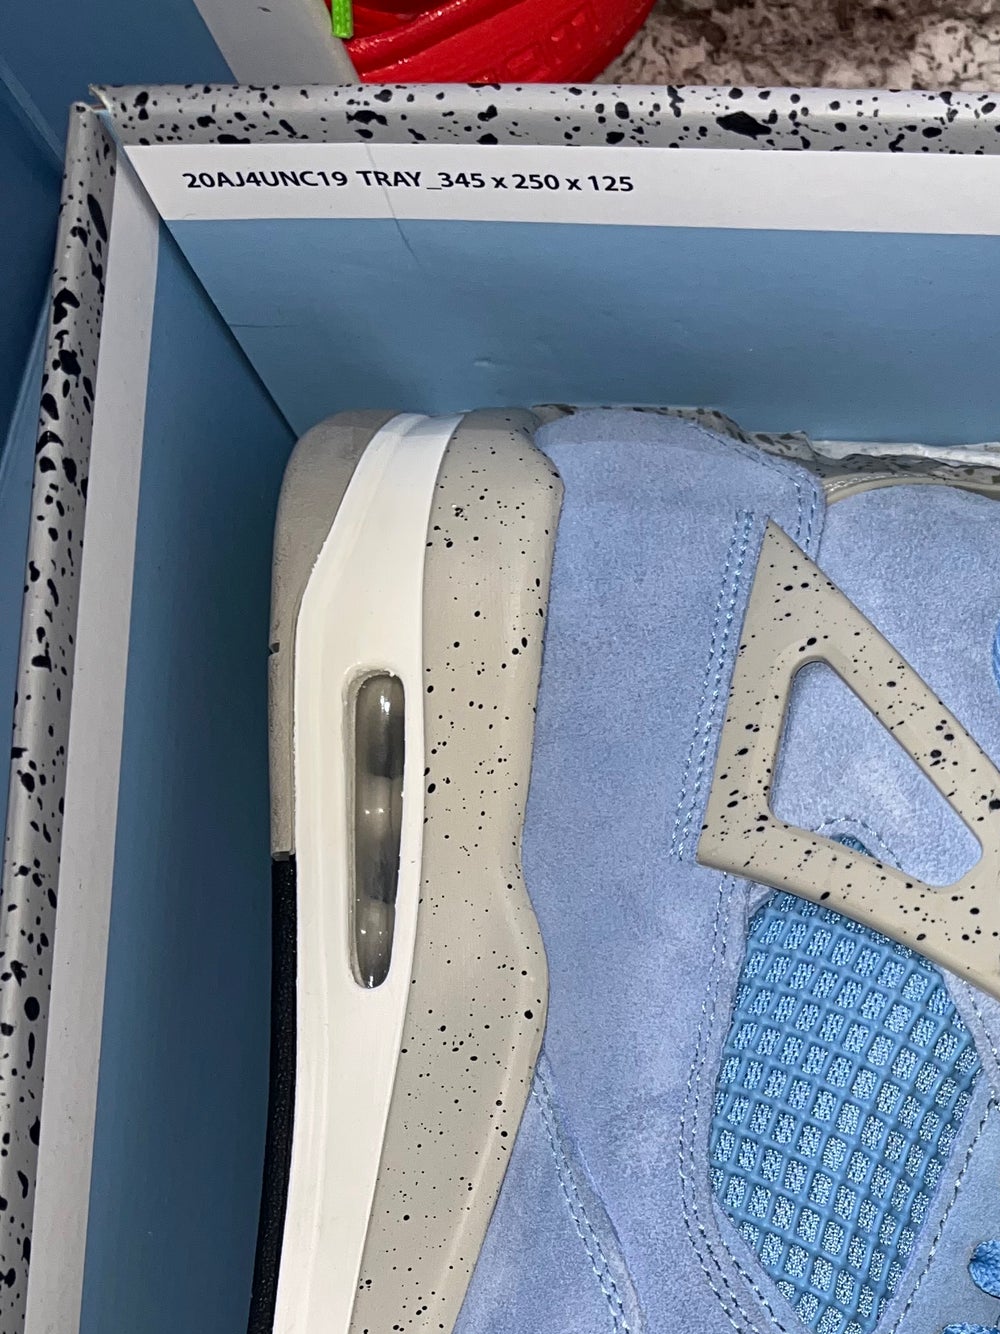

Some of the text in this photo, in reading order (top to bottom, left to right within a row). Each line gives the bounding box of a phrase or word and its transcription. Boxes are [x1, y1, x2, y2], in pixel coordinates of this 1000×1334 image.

[181, 170, 349, 189] 20AJ4UNC19
[355, 170, 422, 188] TRAY
[490, 176, 508, 190] x
[511, 173, 560, 191] 250
[565, 178, 582, 192] x
[587, 175, 635, 192] 125
